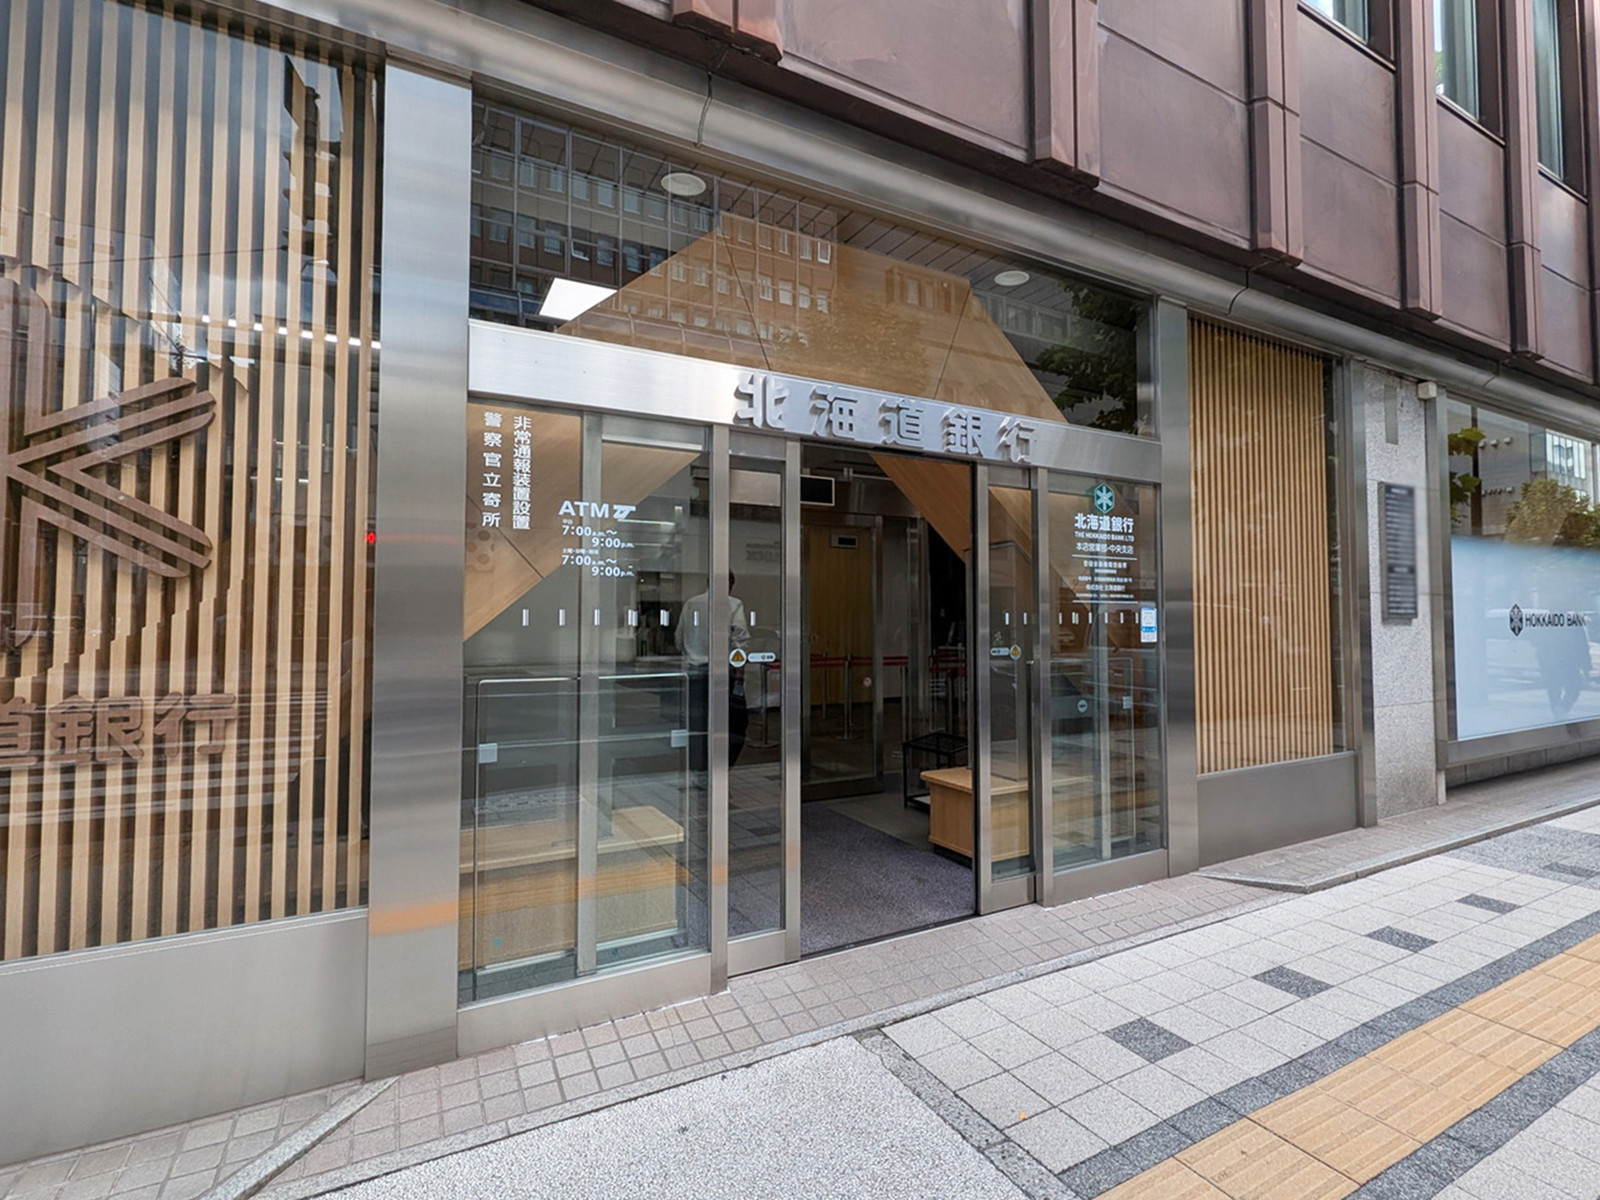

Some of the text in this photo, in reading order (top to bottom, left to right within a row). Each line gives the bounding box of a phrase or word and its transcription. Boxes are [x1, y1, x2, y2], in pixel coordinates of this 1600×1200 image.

[733, 374, 1037, 464] 北海道銀行
[482, 411, 502, 528] 警察官立寄所
[512, 415, 532, 530] 非常通報装置設置
[558, 500, 609, 518] ATM
[1074, 512, 1135, 533] 北海道銀行
[1525, 613, 1565, 628] HOKKAIDO
